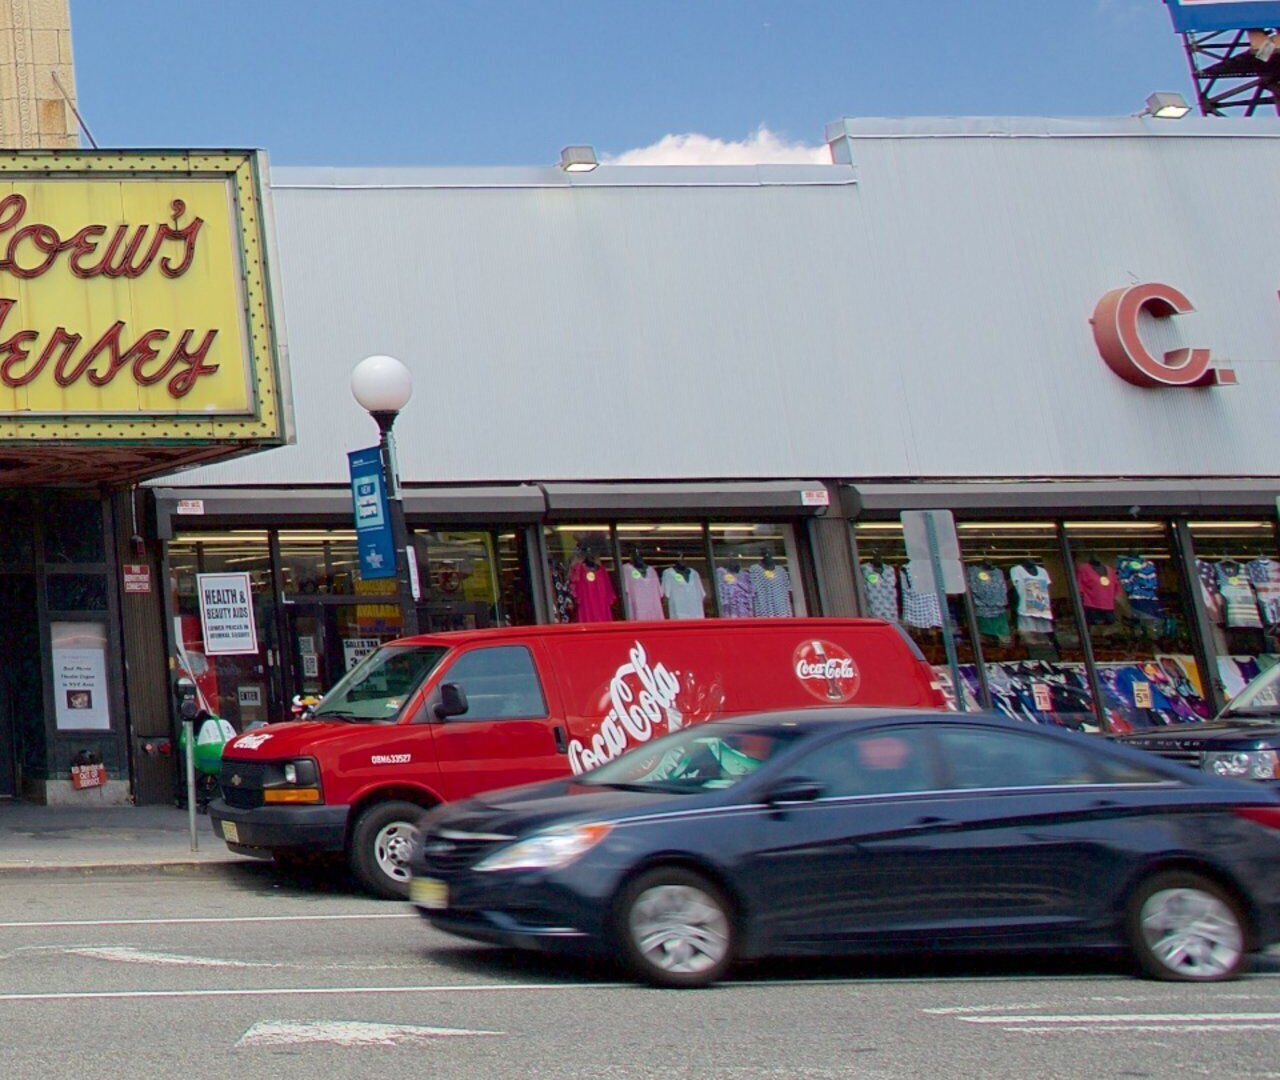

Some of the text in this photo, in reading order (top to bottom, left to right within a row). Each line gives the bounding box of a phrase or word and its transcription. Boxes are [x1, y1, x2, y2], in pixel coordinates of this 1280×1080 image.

[205, 589, 246, 605] HEALTH &
[207, 607, 249, 619] BEAUTY AIDS
